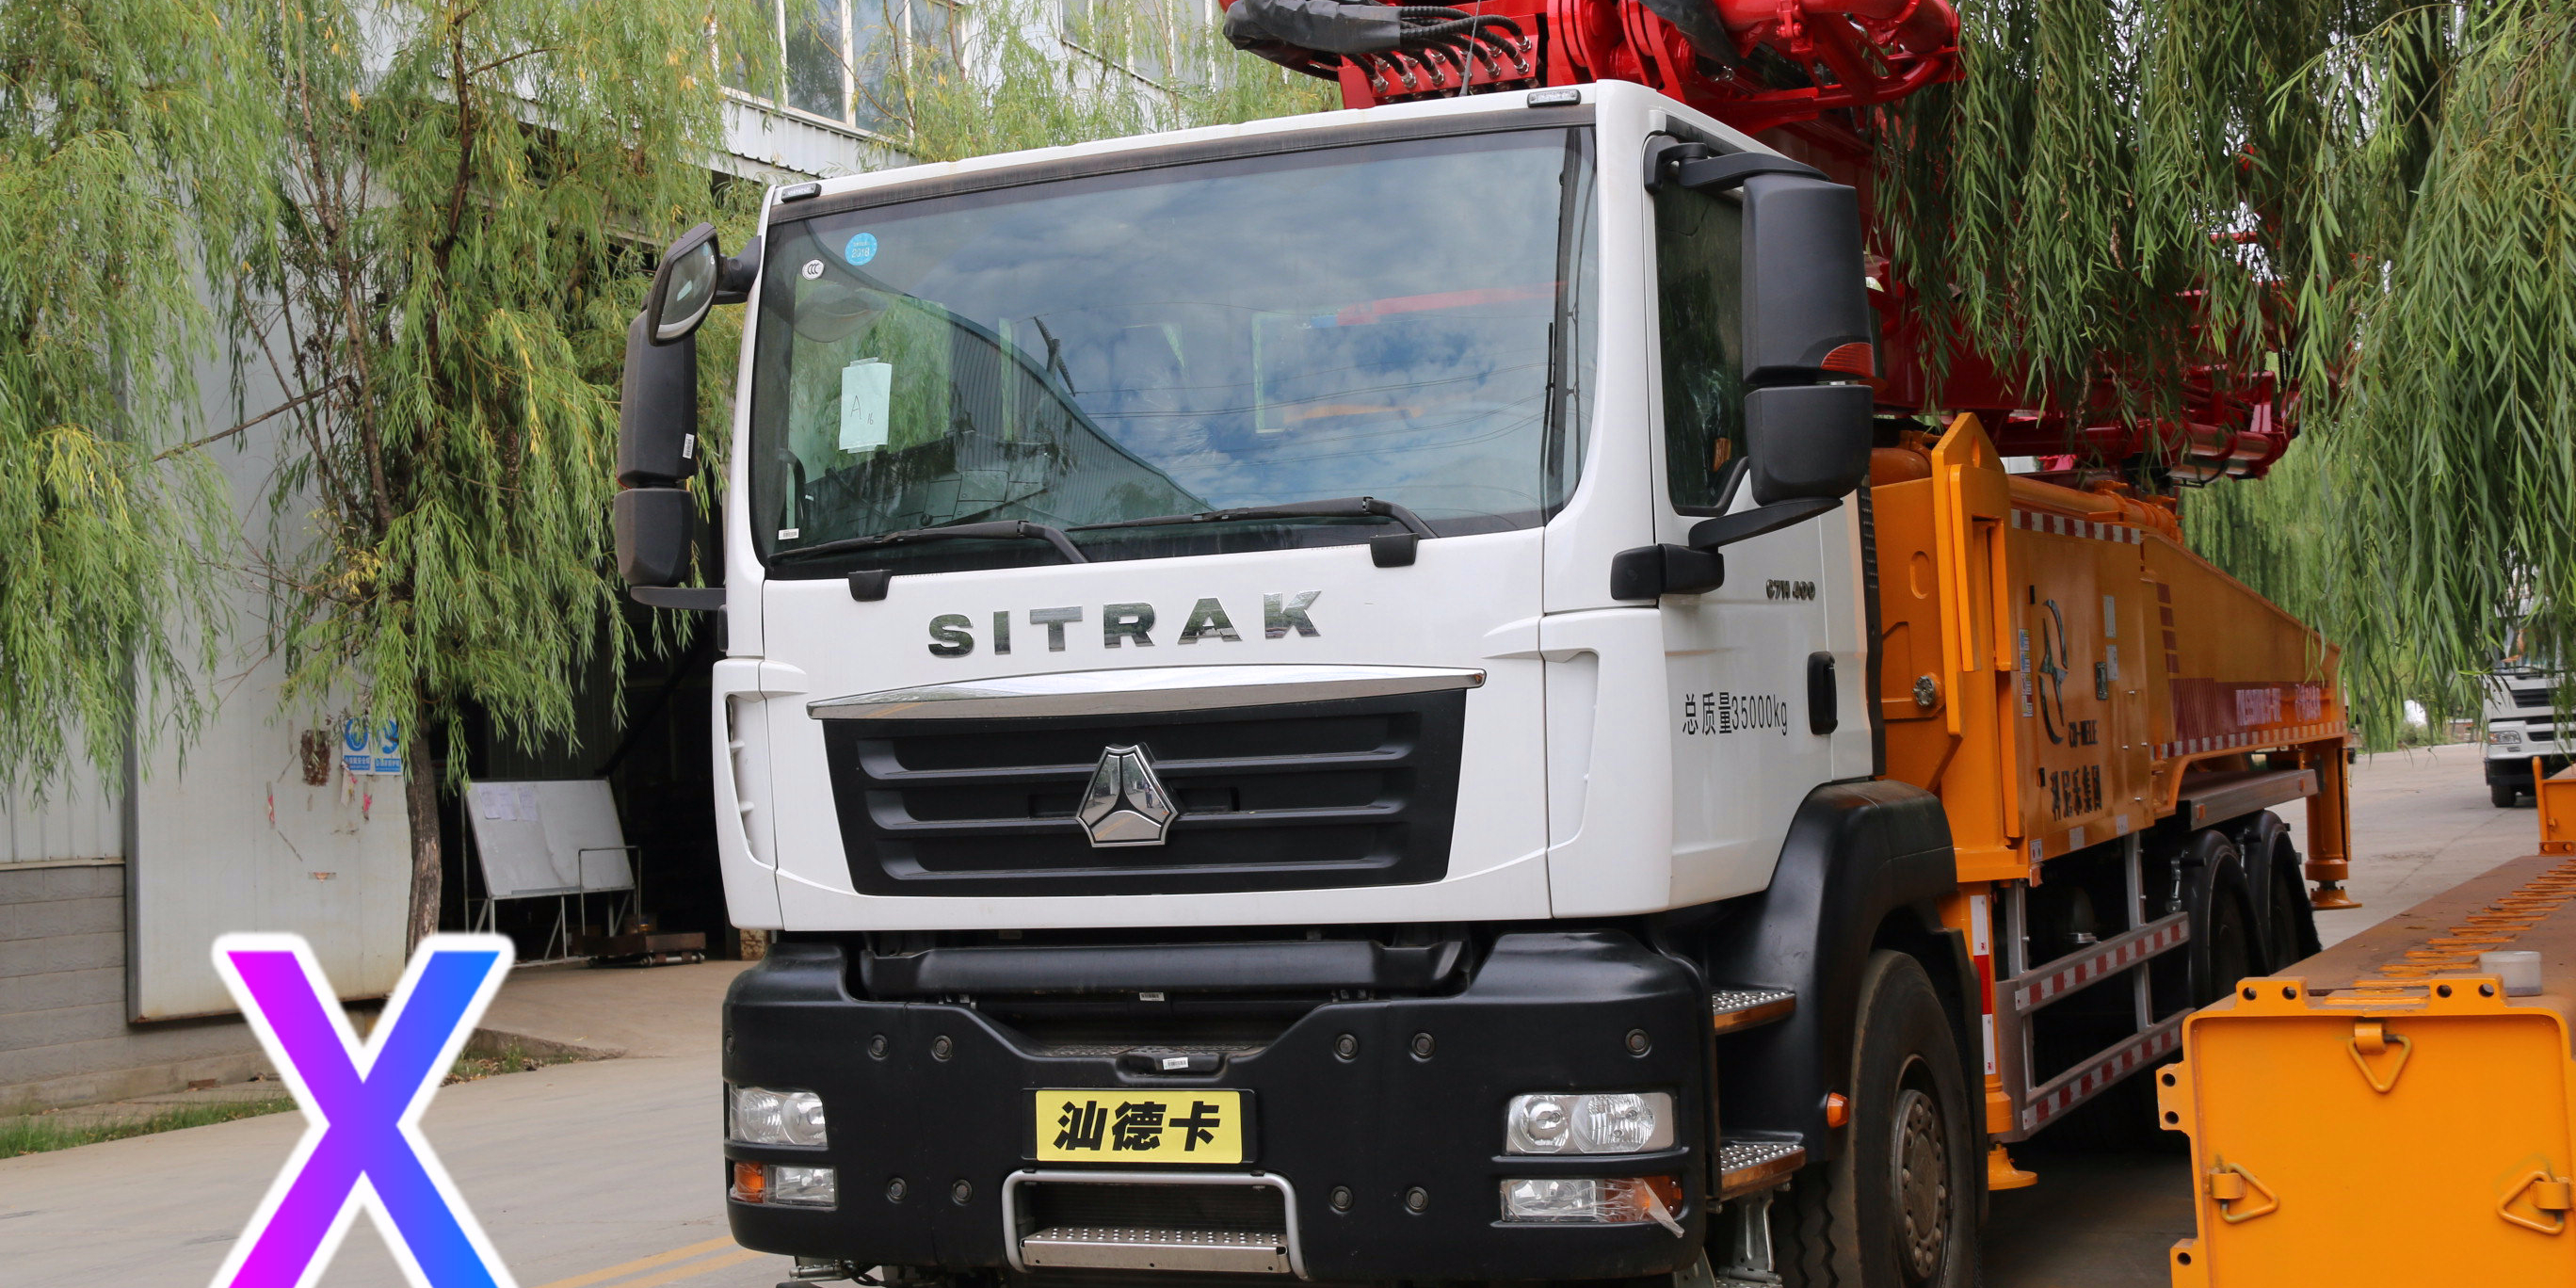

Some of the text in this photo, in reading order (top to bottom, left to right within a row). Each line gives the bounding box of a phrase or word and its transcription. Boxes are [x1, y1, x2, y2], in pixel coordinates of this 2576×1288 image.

[850, 395, 861, 420] A
[1766, 579, 1815, 601] C7H 400
[927, 590, 1322, 659] SITRAK
[1053, 1101, 1220, 1151] 汕德卡
